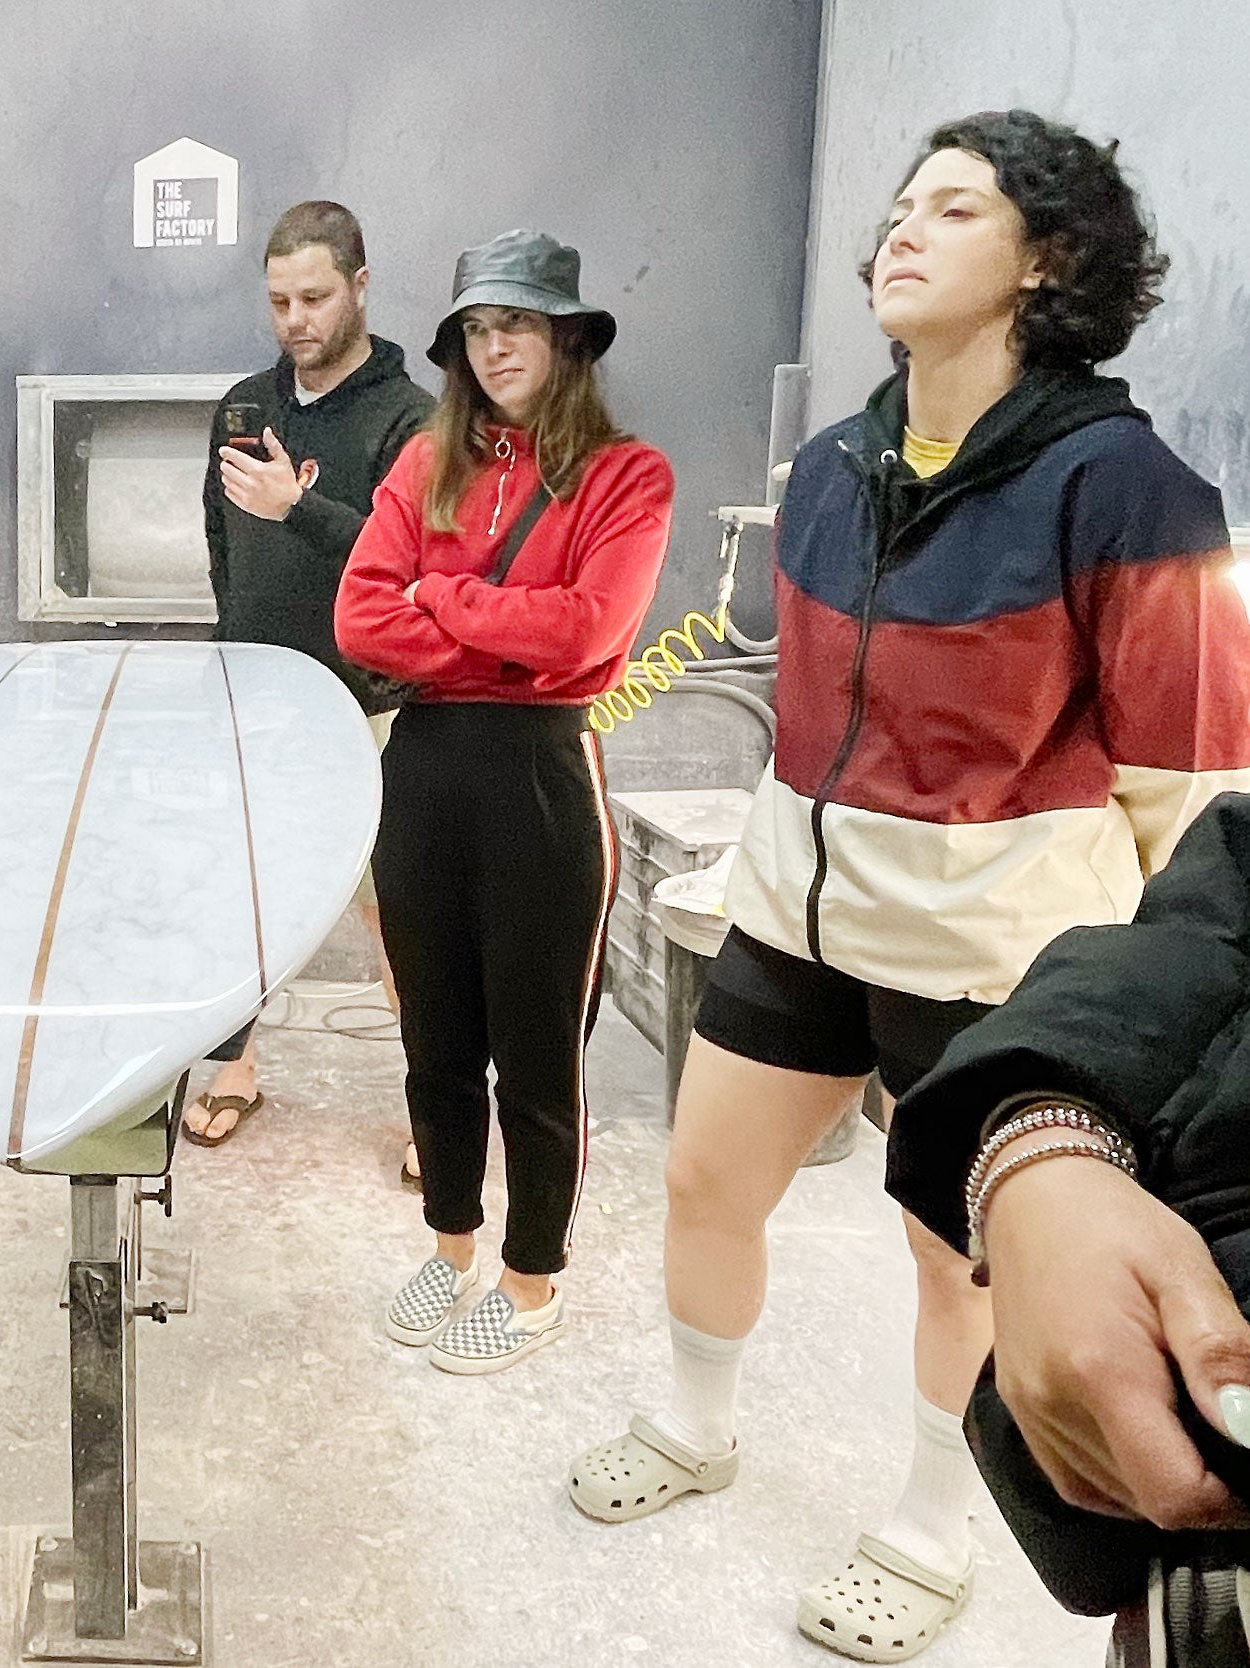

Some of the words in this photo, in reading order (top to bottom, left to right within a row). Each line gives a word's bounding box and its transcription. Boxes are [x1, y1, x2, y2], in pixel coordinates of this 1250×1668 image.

[156, 181, 182, 199] THE
[156, 201, 191, 218] SURF
[155, 219, 215, 237] FACTORY
